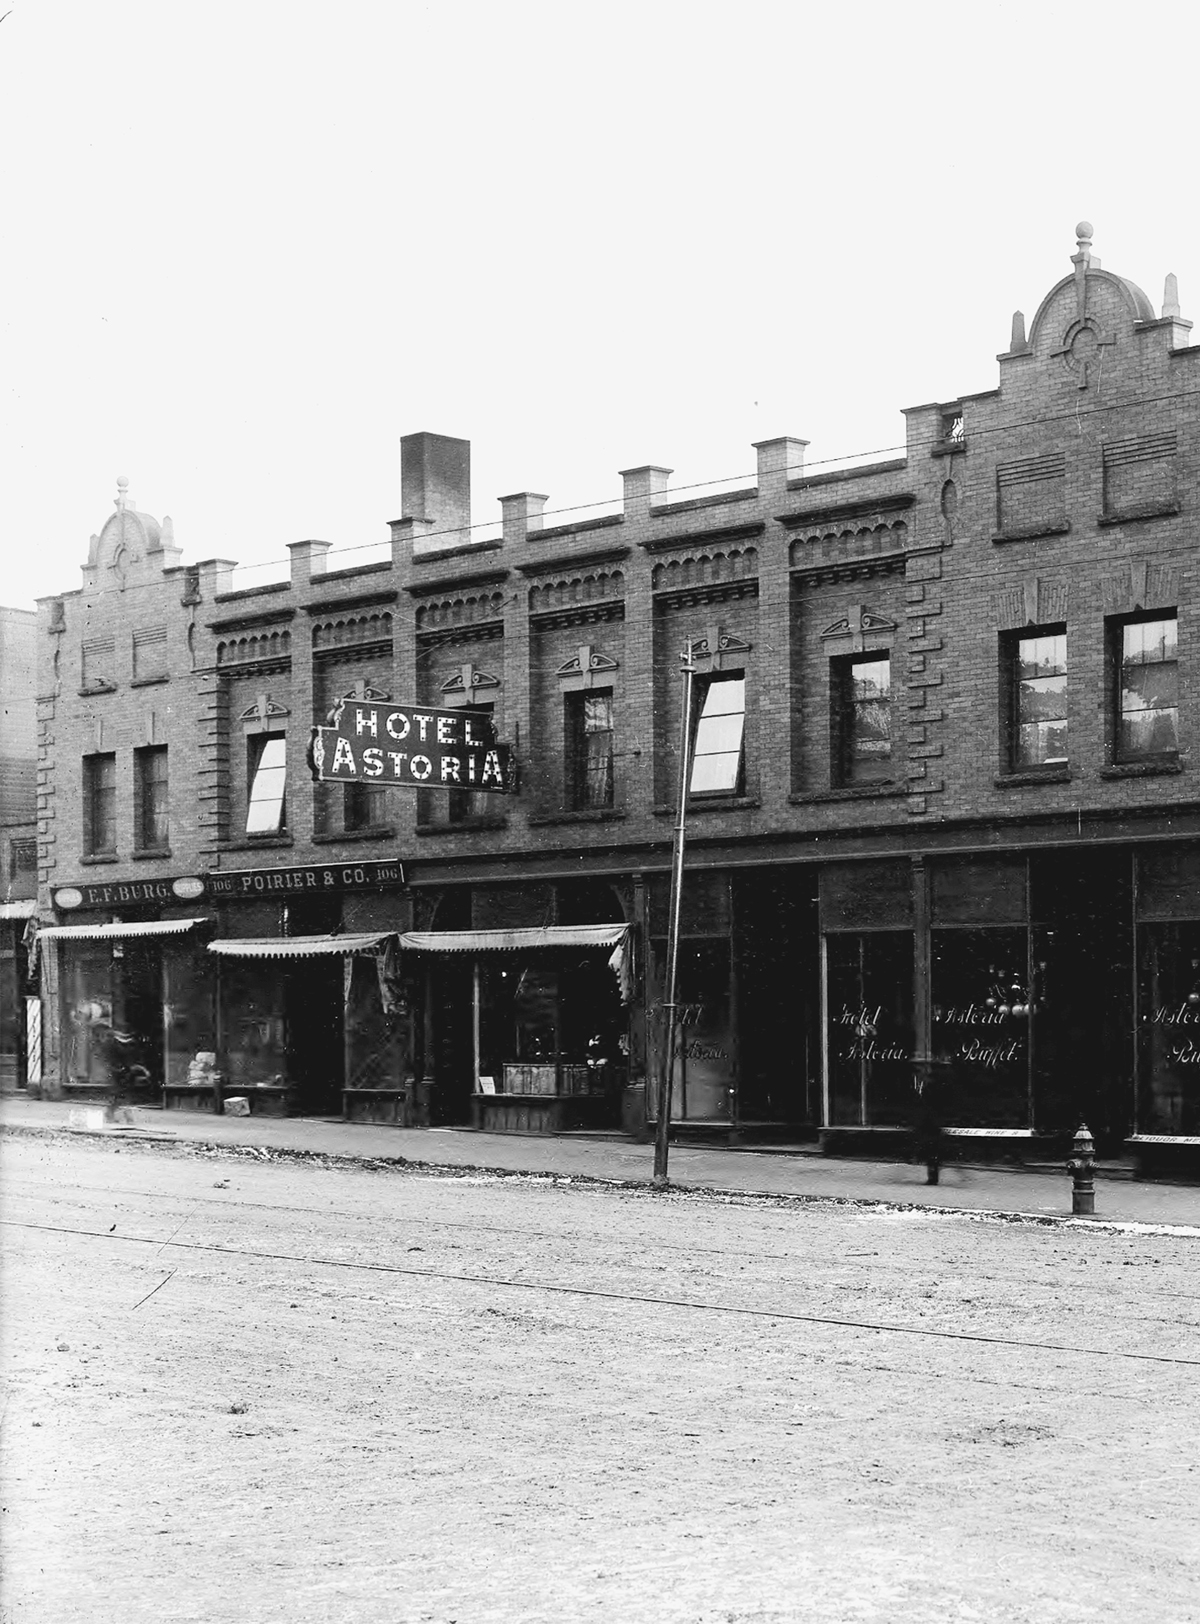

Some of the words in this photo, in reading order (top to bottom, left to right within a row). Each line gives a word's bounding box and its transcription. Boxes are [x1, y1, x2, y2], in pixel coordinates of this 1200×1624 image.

[356, 709, 483, 747] HOTEL
[332, 737, 503, 784] ASTORIA
[213, 880, 232, 892] 106
[242, 872, 317, 891] POIRIER
[323, 872, 335, 885] &
[343, 868, 370, 884] CO.
[377, 868, 398, 881] 106
